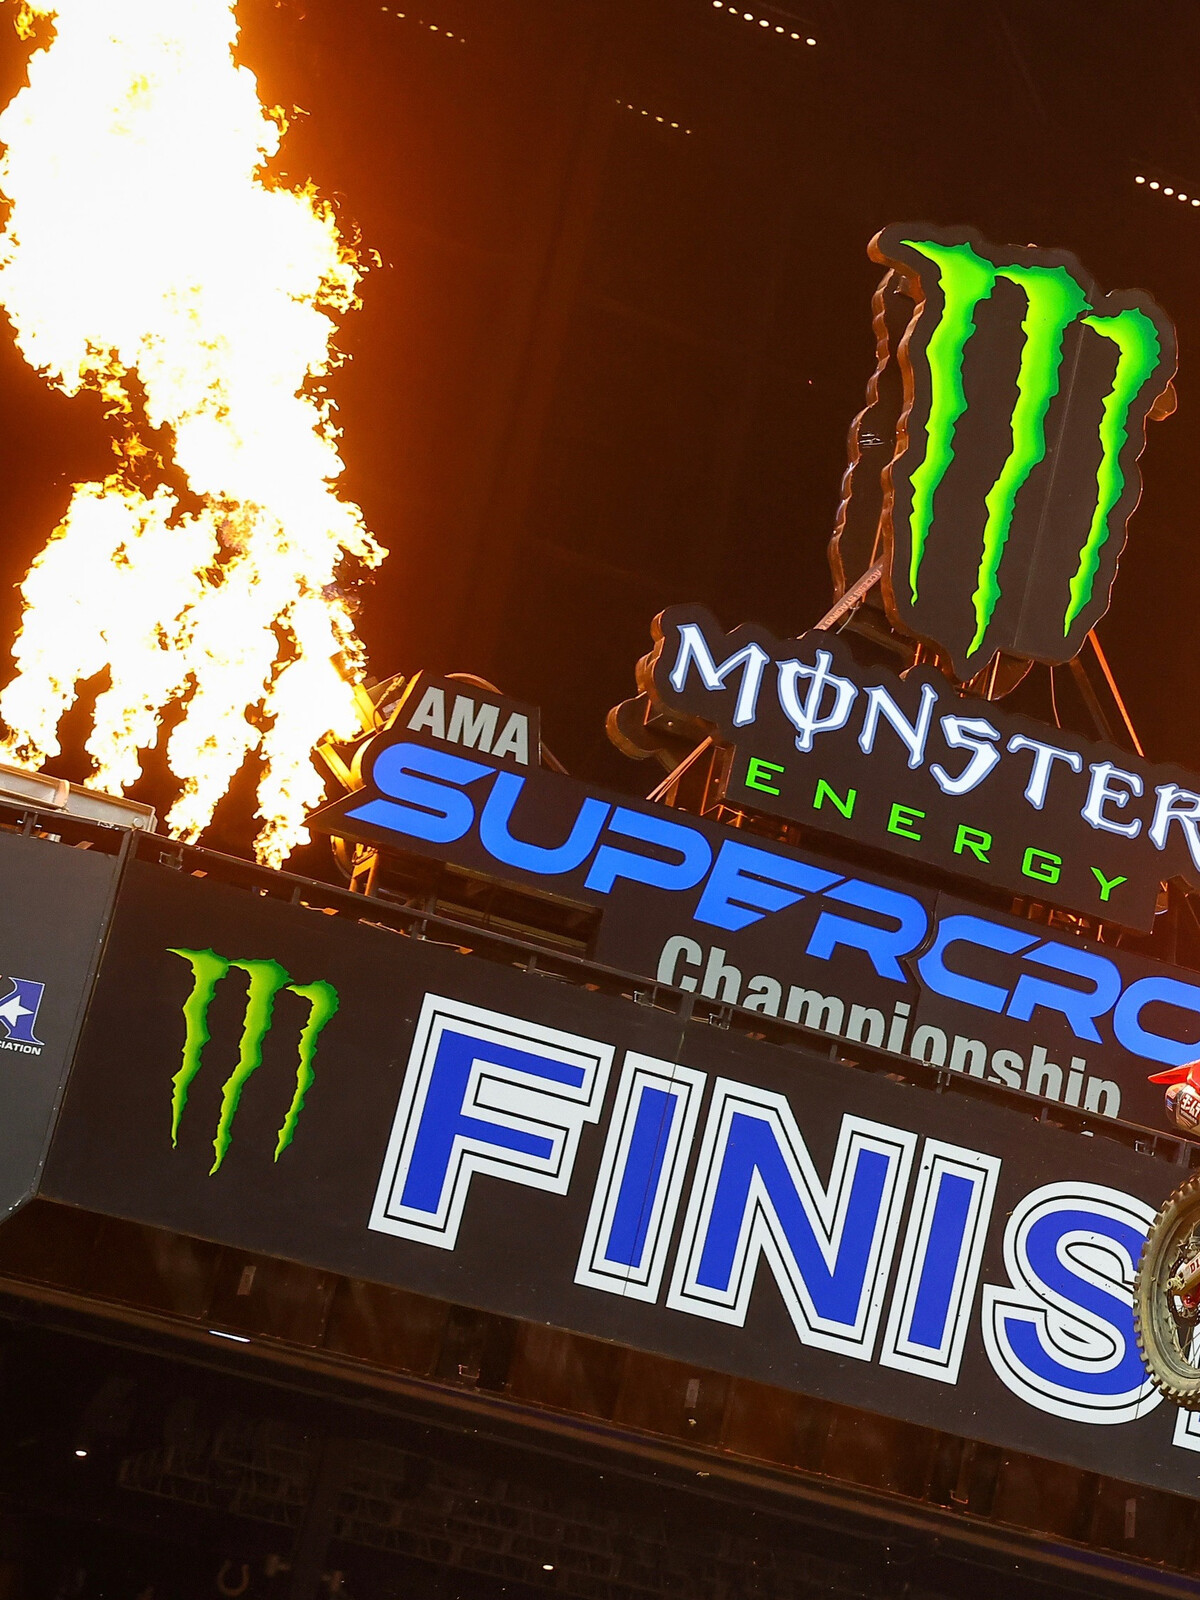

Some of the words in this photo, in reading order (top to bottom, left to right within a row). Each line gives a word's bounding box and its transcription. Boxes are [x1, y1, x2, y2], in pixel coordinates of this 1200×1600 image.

[407, 686, 528, 765] AMA
[745, 757, 1127, 902] ENERGY
[0, 1041, 41, 1056] IATION
[656, 935, 1121, 1119] Championship
